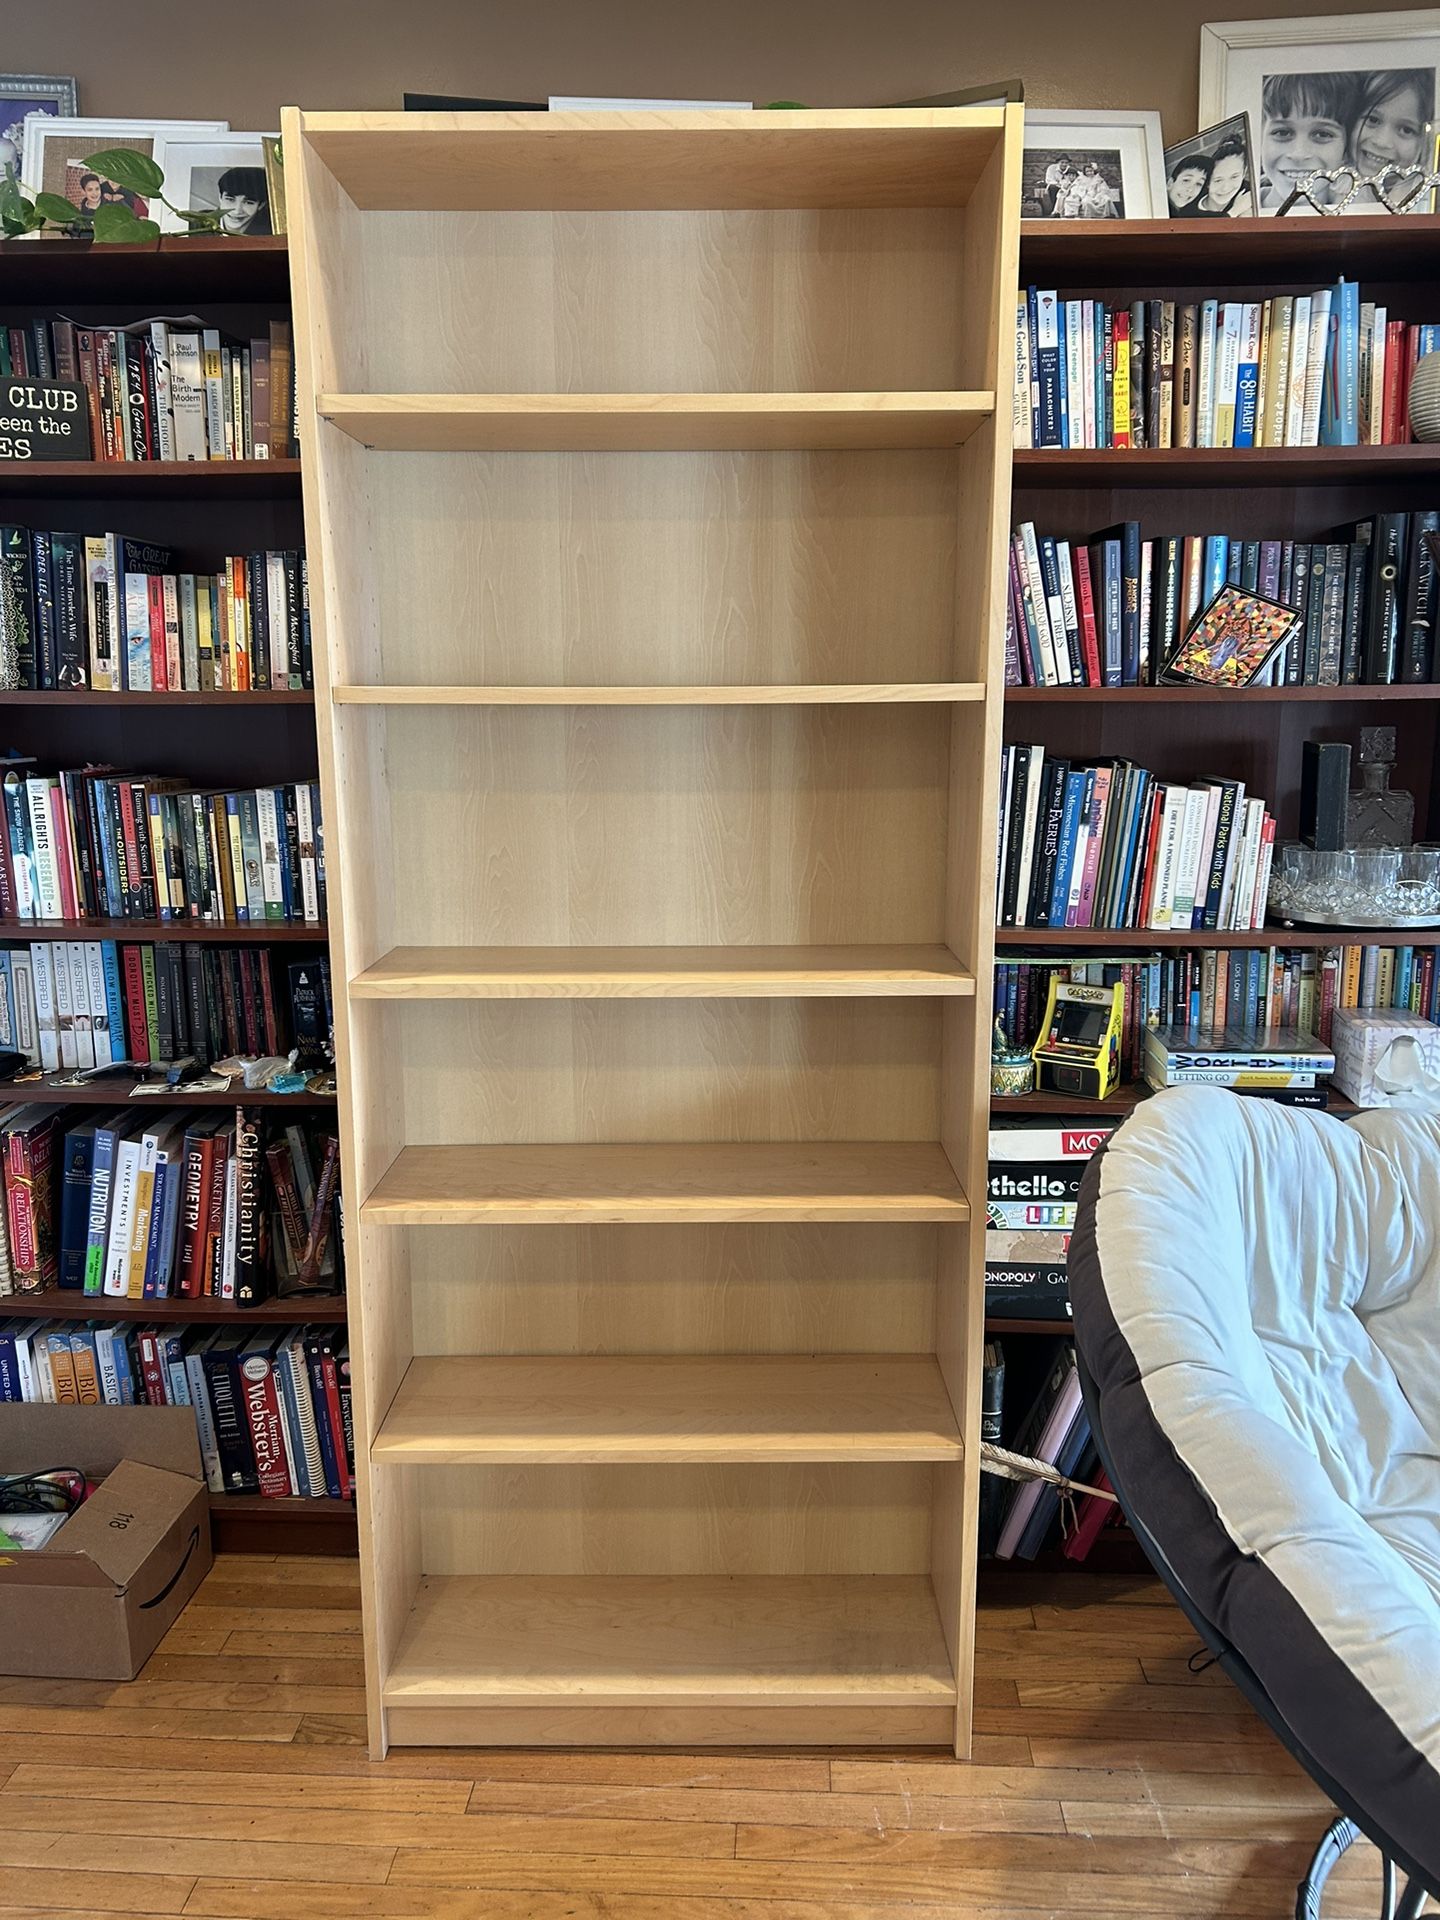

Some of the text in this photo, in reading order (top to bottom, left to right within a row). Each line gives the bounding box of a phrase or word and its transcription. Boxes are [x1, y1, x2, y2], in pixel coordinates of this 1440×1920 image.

[1104, 313, 1112, 333] PLEASE
[1226, 330, 1237, 338] 7
[1246, 306, 1258, 360] Stephen Covey
[1346, 310, 1352, 320] TO
[176, 343, 192, 351] Paul
[1016, 306, 1027, 385] The Good Son
[1104, 335, 1112, 371] UNDERSTAND
[1152, 328, 1161, 350] Love
[1163, 315, 1173, 361] Love Dare
[1183, 314, 1194, 364] Love Dare
[1295, 306, 1307, 368] MINDFULNESS
[128, 358, 141, 391] 1984
[172, 375, 186, 384] The
[172, 384, 192, 393] Birth
[1273, 305, 1292, 443] POSITIVE POWER PEOPLE
[9, 386, 78, 411] CLUB
[172, 393, 200, 402] Modern
[1240, 369, 1256, 434] The 8th HABIT
[38, 416, 71, 435] the
[159, 394, 170, 456] THE CHOICE
[35, 535, 48, 595] HARPER LEE
[142, 546, 171, 565] GREAT
[288, 569, 295, 580] TO
[66, 549, 78, 642] The Time Traveler's Wife
[1079, 556, 1091, 606] bell hooks
[1416, 571, 1431, 615] WITCH
[1031, 570, 1050, 649] THE HAND OF GOD
[1063, 584, 1077, 629] INSECTS
[1086, 622, 1094, 634] all
[1383, 589, 1391, 632] STEPHENIE
[287, 615, 301, 666] Mockingbird
[1053, 618, 1065, 649] TREES
[1087, 634, 1096, 654] about
[130, 669, 138, 687] BEAR
[1055, 786, 1062, 797] TO
[1057, 767, 1065, 786] HOW
[134, 791, 148, 872] Running with Scissors
[1011, 812, 1022, 854] Christianity
[1044, 807, 1063, 857] FAERIES
[1058, 794, 1077, 881] Micronesian Reef Fishes
[1170, 809, 1178, 825] DIET
[1211, 787, 1235, 889] National Parks with Kids
[38, 851, 54, 901] RESERVED
[117, 840, 128, 894] OUTSIDERS
[127, 840, 140, 881] FAHRENHEIT
[1087, 841, 1097, 874] Manual
[1163, 848, 1172, 882] POISONED
[1160, 883, 1168, 909] PLANET
[37, 957, 49, 1010] WESTERFELD
[56, 958, 68, 1009] WESTERFELD
[74, 958, 85, 1010] WESTERFELD
[91, 959, 102, 1011] WESTERFELD
[128, 957, 140, 996] DOROTHY
[144, 956, 155, 1021] THE WICKED WILL
[1233, 979, 1241, 1001] LOWRY
[106, 956, 123, 1044] YELLOW BRICK WAR
[133, 998, 141, 1022] MUST
[1173, 1073, 1230, 1082] LETTING GO
[1175, 1054, 1285, 1070] WORTHY
[1069, 1134, 1105, 1151] MO
[90, 1168, 110, 1234] NUTRITION
[120, 1160, 132, 1228] INVESTMENTS
[186, 1152, 203, 1231] GEOMETRY
[211, 1158, 224, 1223] MARKETING
[237, 1132, 259, 1265] Christianity
[988, 1176, 1066, 1196] thello
[15, 1192, 30, 1265] RELATIONSHIPS
[132, 1208, 149, 1251] Marketing
[151, 1172, 165, 1248] STRATEGIC MANAGEMENT
[1028, 1207, 1075, 1225] LIFE
[0, 1359, 11, 1388] UNITED
[104, 1365, 117, 1394] BASIC
[212, 1374, 237, 1429] ETIQUETTE
[247, 1381, 275, 1472] Webster's
[109, 1512, 134, 1530] 118
